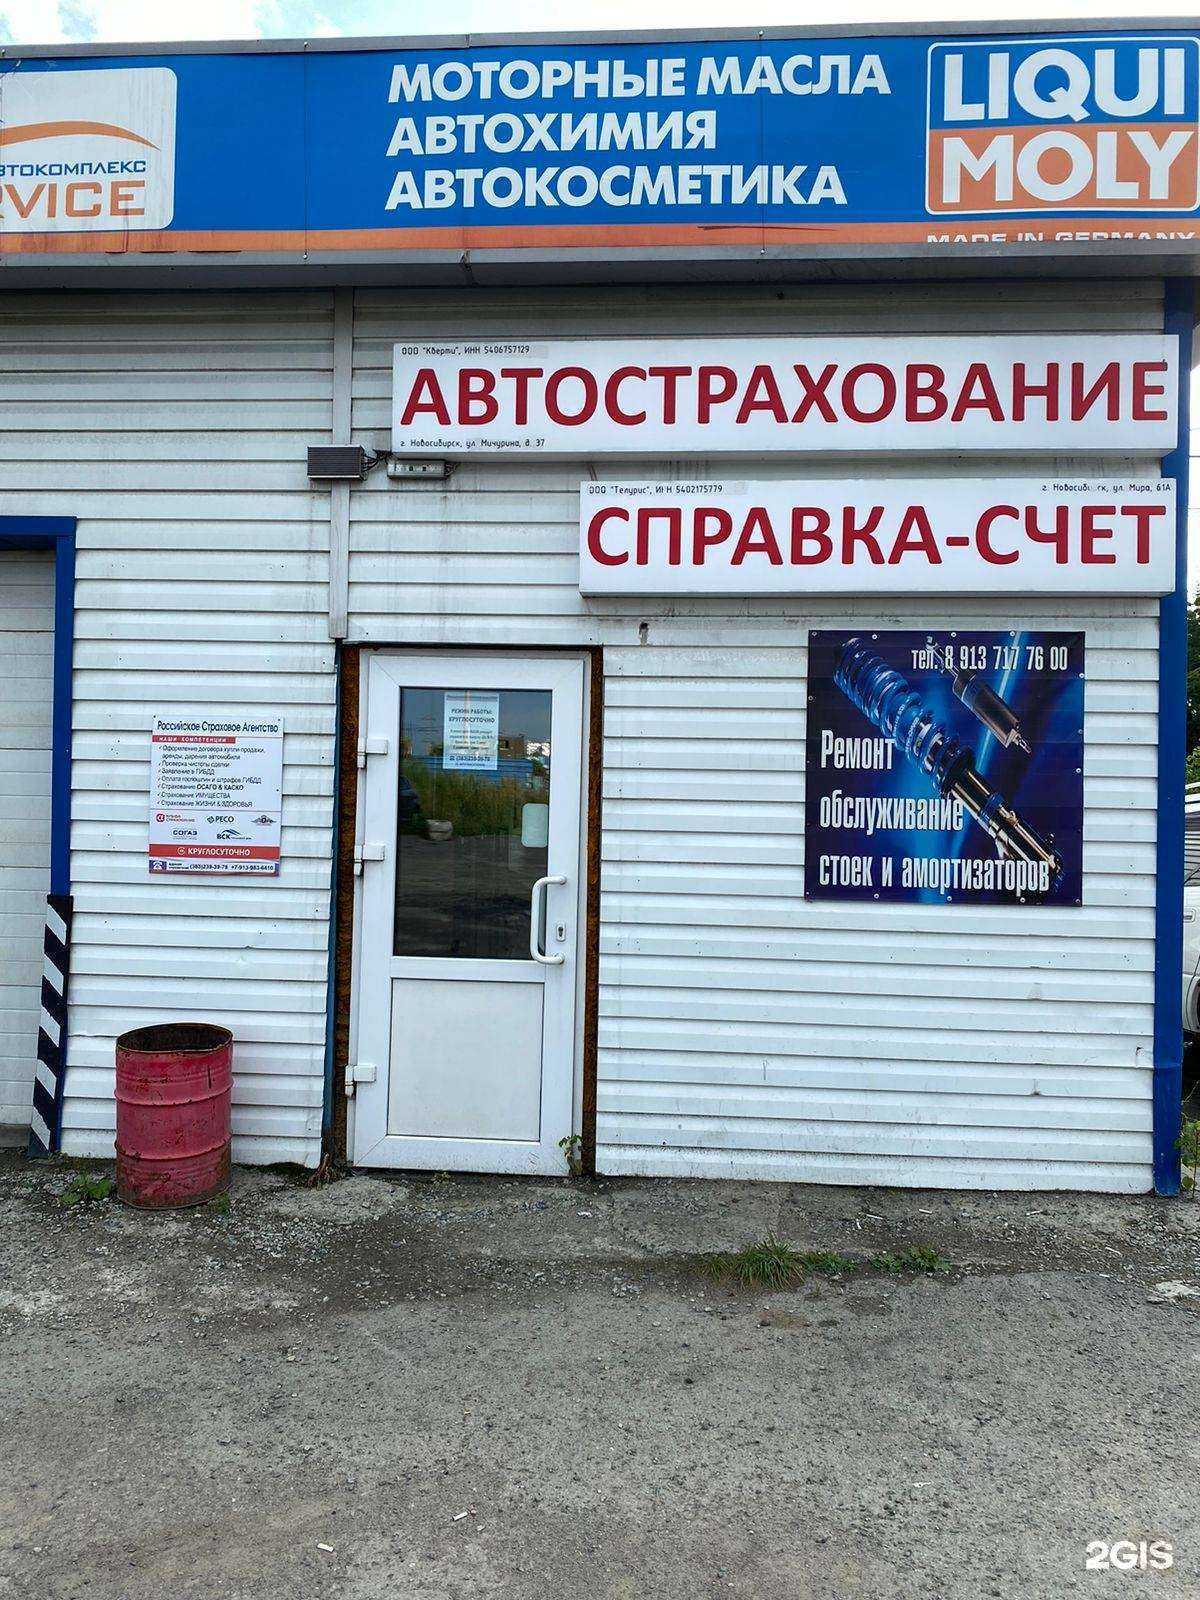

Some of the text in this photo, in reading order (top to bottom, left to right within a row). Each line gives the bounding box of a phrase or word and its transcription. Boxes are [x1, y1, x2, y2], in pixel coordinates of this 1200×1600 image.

[388, 54, 892, 103] МОТОРНЫЕ МАСЛА
[943, 48, 1185, 121] LIQUI
[386, 110, 717, 157] АВТОХИМИЯ
[942, 130, 1194, 203] MOLY
[0, 180, 146, 218] VICE
[384, 165, 848, 210] АВТОКОСМЕТИКА
[401, 346, 419, 356] ООО
[464, 346, 480, 354] ИНН
[484, 345, 530, 355] 5406757129
[400, 361, 1169, 426] АВТОСТРАХОВАНИЕ
[410, 439, 463, 449] Новосибирск,
[480, 439, 521, 449] Мичурина,
[535, 438, 545, 447] 37
[589, 486, 607, 494] ООО
[1156, 483, 1171, 491] 61А
[587, 504, 1167, 566] СПРАВКА-СЧЕТ
[911, 645, 1068, 671] тел. 8 913 717 76 00
[157, 720, 279, 733] Российское Страховое Агентство
[821, 730, 895, 770] Ремонт
[215, 815, 235, 823] РЕСО
[819, 790, 964, 835] обслуживание
[187, 847, 251, 856] КРУГЛОСУТОЧНО
[819, 855, 1050, 897] стоек и амортизаторов
